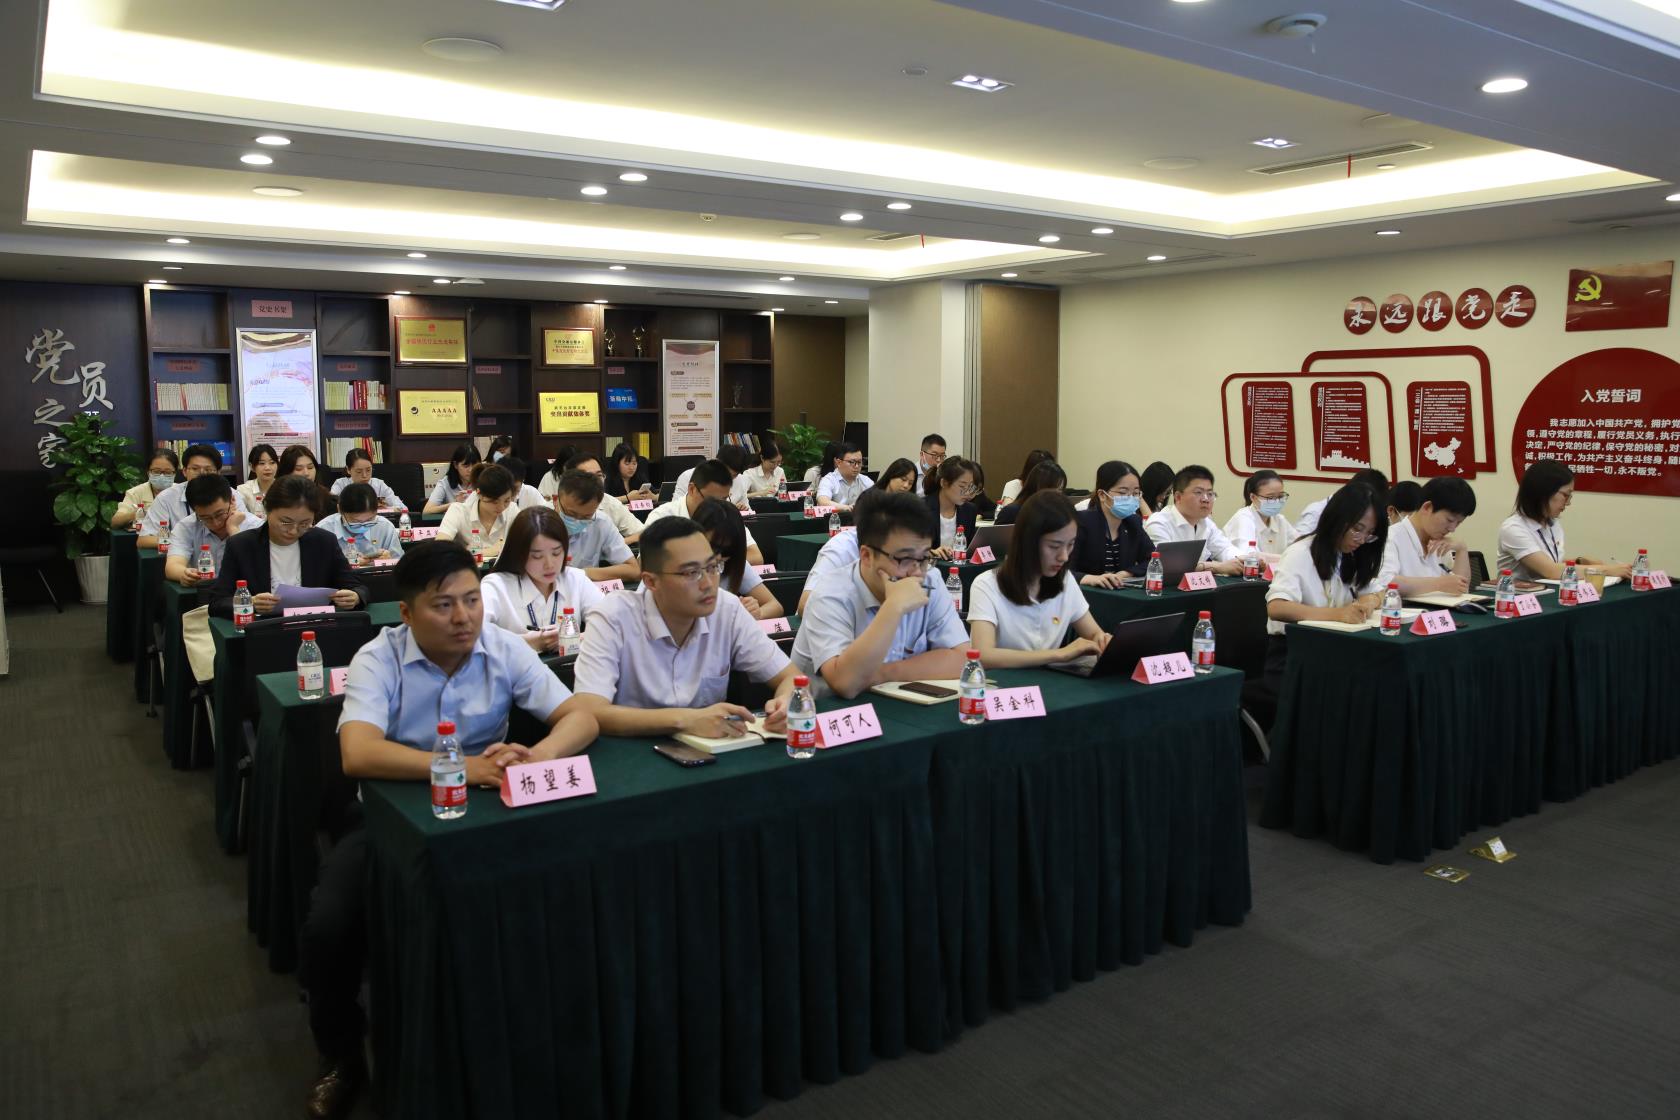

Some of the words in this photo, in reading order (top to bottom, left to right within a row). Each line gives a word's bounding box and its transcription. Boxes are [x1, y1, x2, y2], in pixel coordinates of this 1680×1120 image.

[1350, 291, 1528, 327] 永远跟党走
[1580, 389, 1642, 403] 入党誓词
[1525, 452, 1680, 465] 诚，积极工作，为共产主义奋斗终身，随
[829, 713, 872, 737] 何可人
